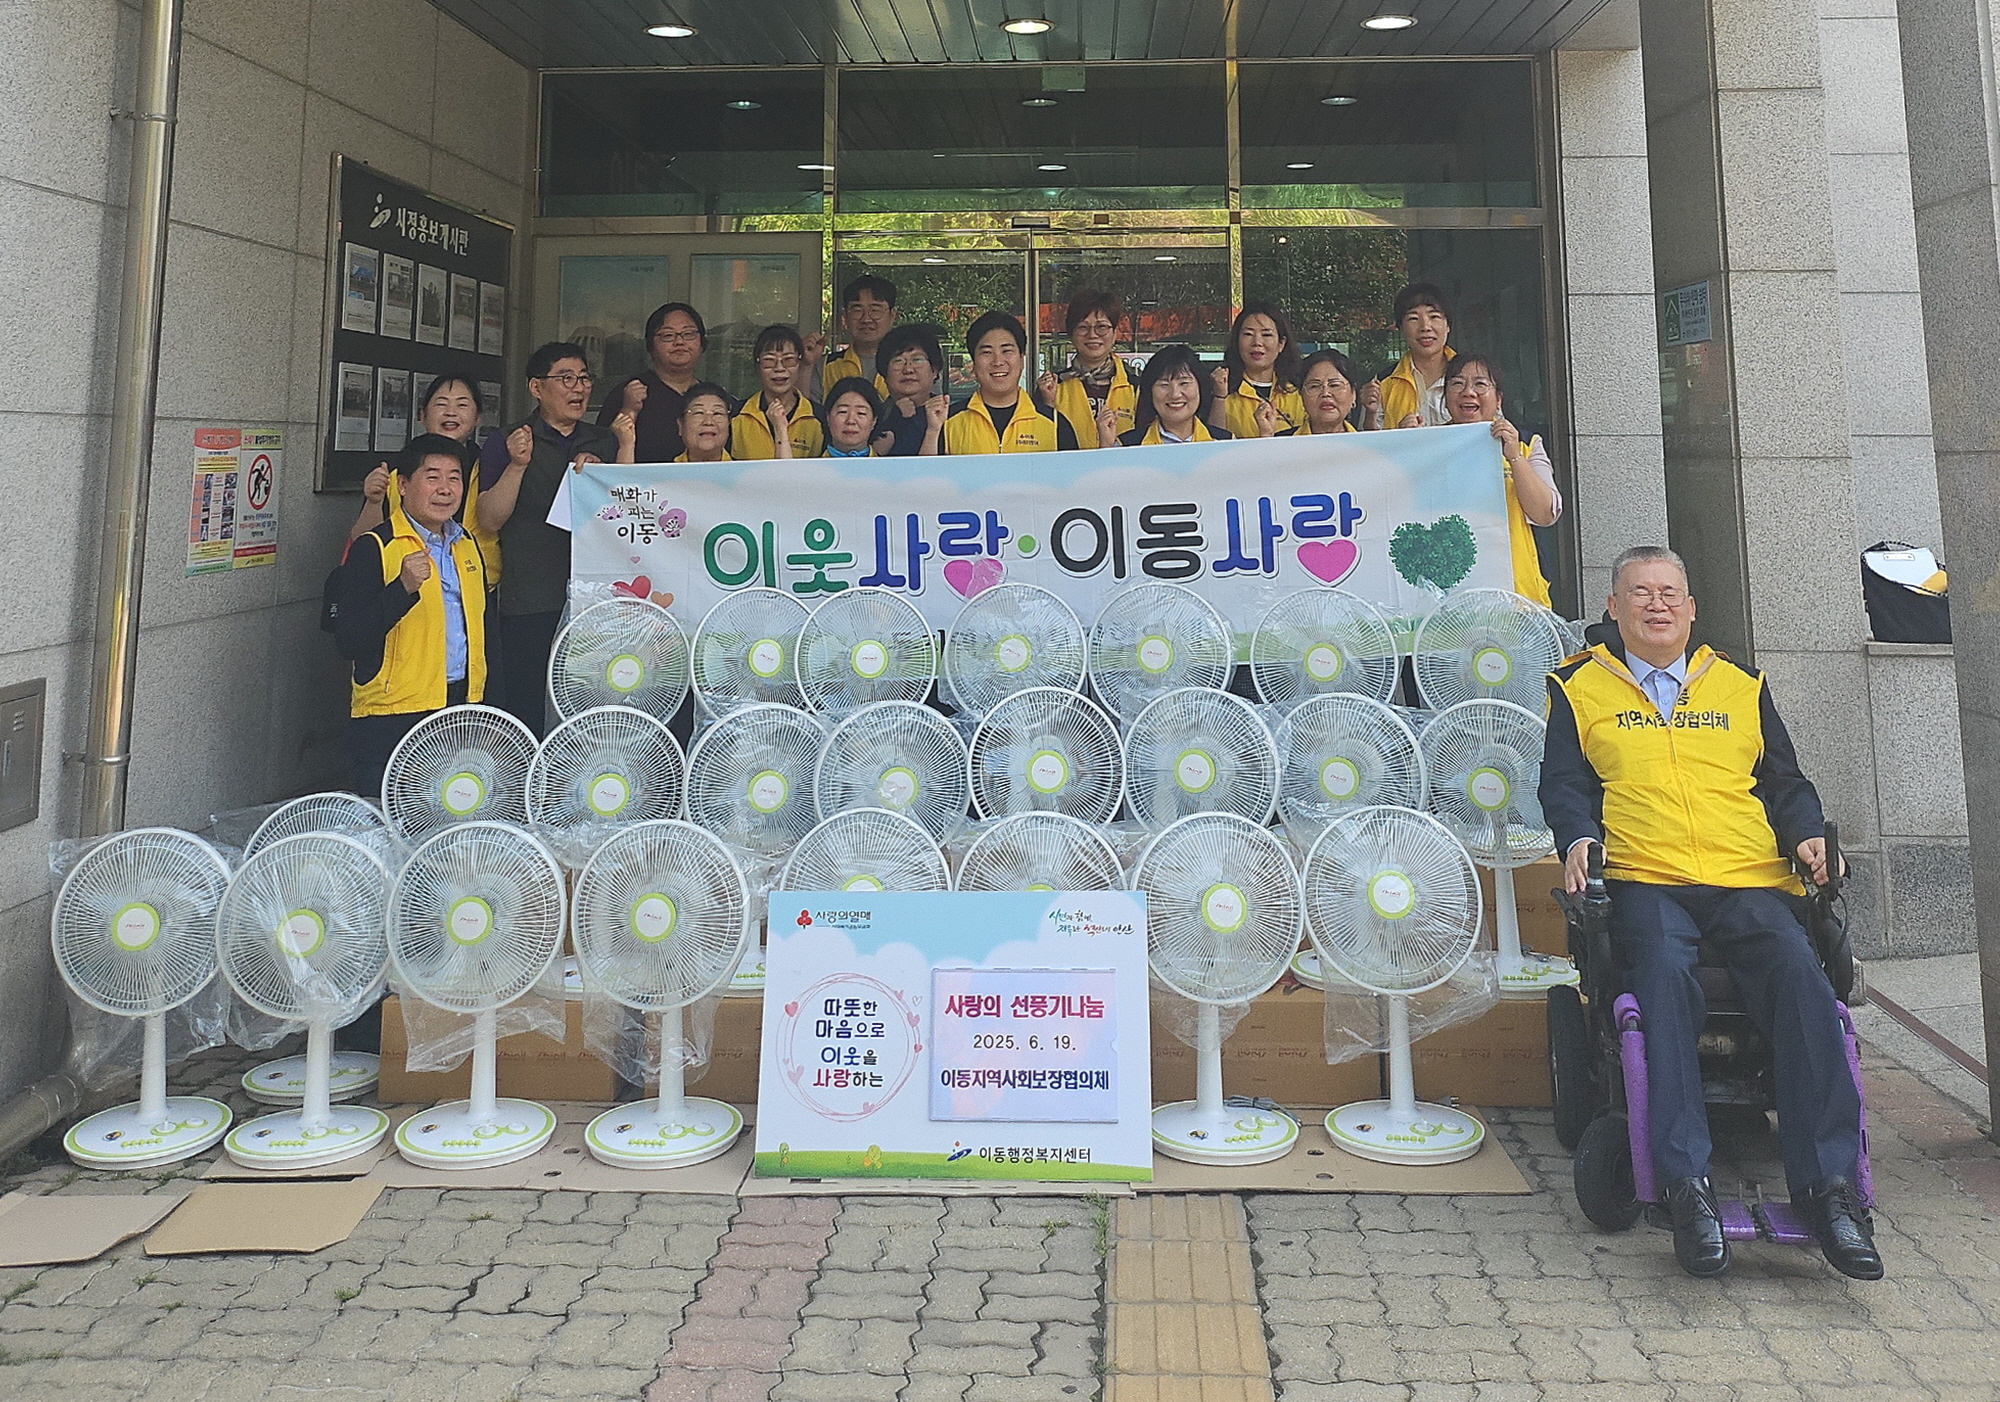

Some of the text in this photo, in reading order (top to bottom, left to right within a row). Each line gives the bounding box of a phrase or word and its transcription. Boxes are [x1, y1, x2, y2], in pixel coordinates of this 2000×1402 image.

[395, 206, 469, 256] 시정홍보게시판
[610, 486, 658, 503] 매화가
[628, 505, 655, 520] 피는
[617, 522, 659, 544] 이동
[1615, 710, 1730, 731] 지역사회장협의체
[815, 910, 871, 923] 사랑의열매
[824, 998, 878, 1018] 따뜻한
[944, 994, 1105, 1018] 사랑의 선풍기나눔
[815, 1020, 885, 1039] 마음으로
[973, 1034, 1077, 1051] 2025. 6. 19.
[820, 1045, 878, 1065] 이웃을
[813, 1069, 884, 1088] 사랑하는
[941, 1069, 1110, 1091] 이동지역사회보장협의체
[978, 1146, 1092, 1164] 이동행정복지센터
